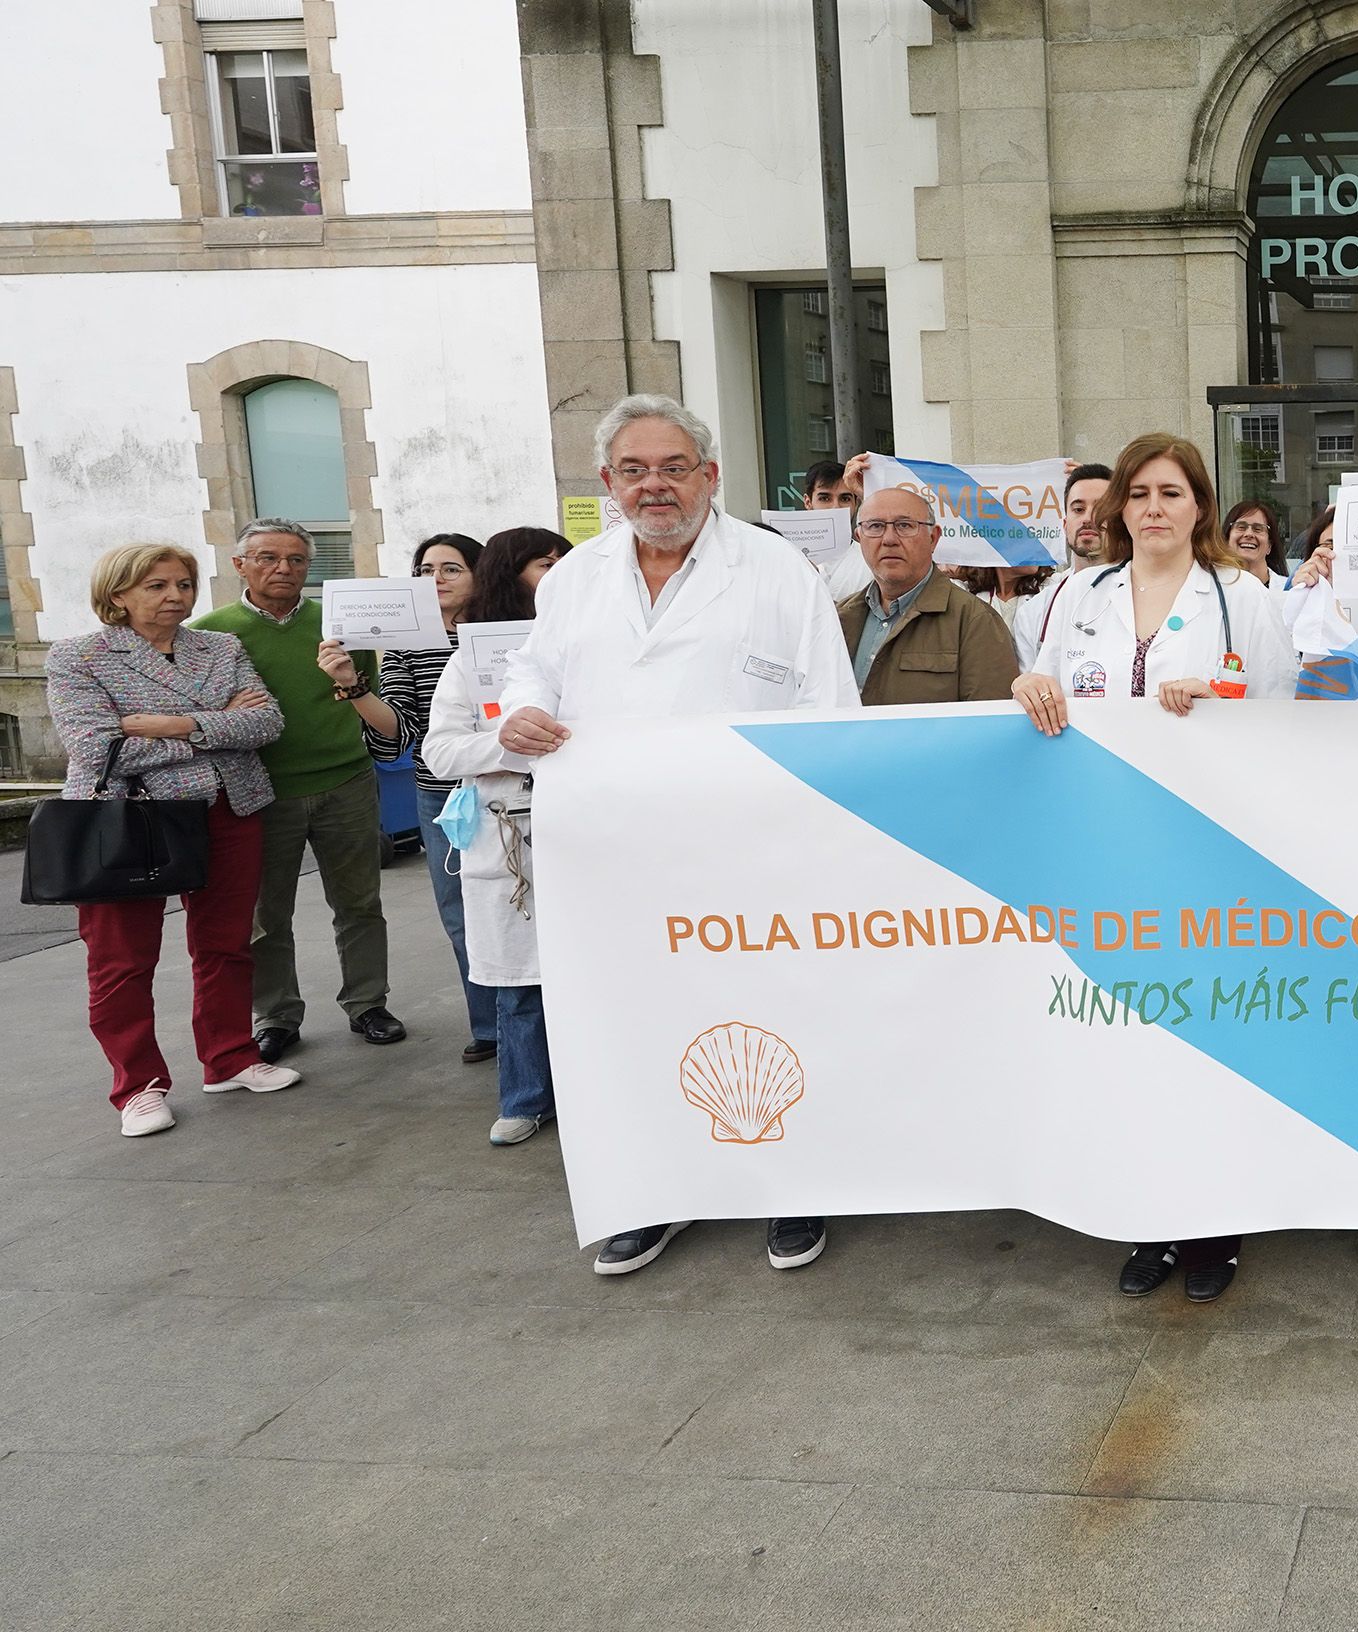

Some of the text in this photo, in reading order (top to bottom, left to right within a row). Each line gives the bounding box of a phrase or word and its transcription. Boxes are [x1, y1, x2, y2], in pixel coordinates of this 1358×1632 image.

[959, 525, 1005, 538] Médico
[1008, 526, 1023, 539] de
[666, 913, 801, 953] POLA
[811, 904, 1080, 950] DIGNIDADE
[1093, 909, 1162, 952] DE
[1048, 973, 1194, 1027] XUNTOS
[1210, 966, 1311, 1024] MÁIS
